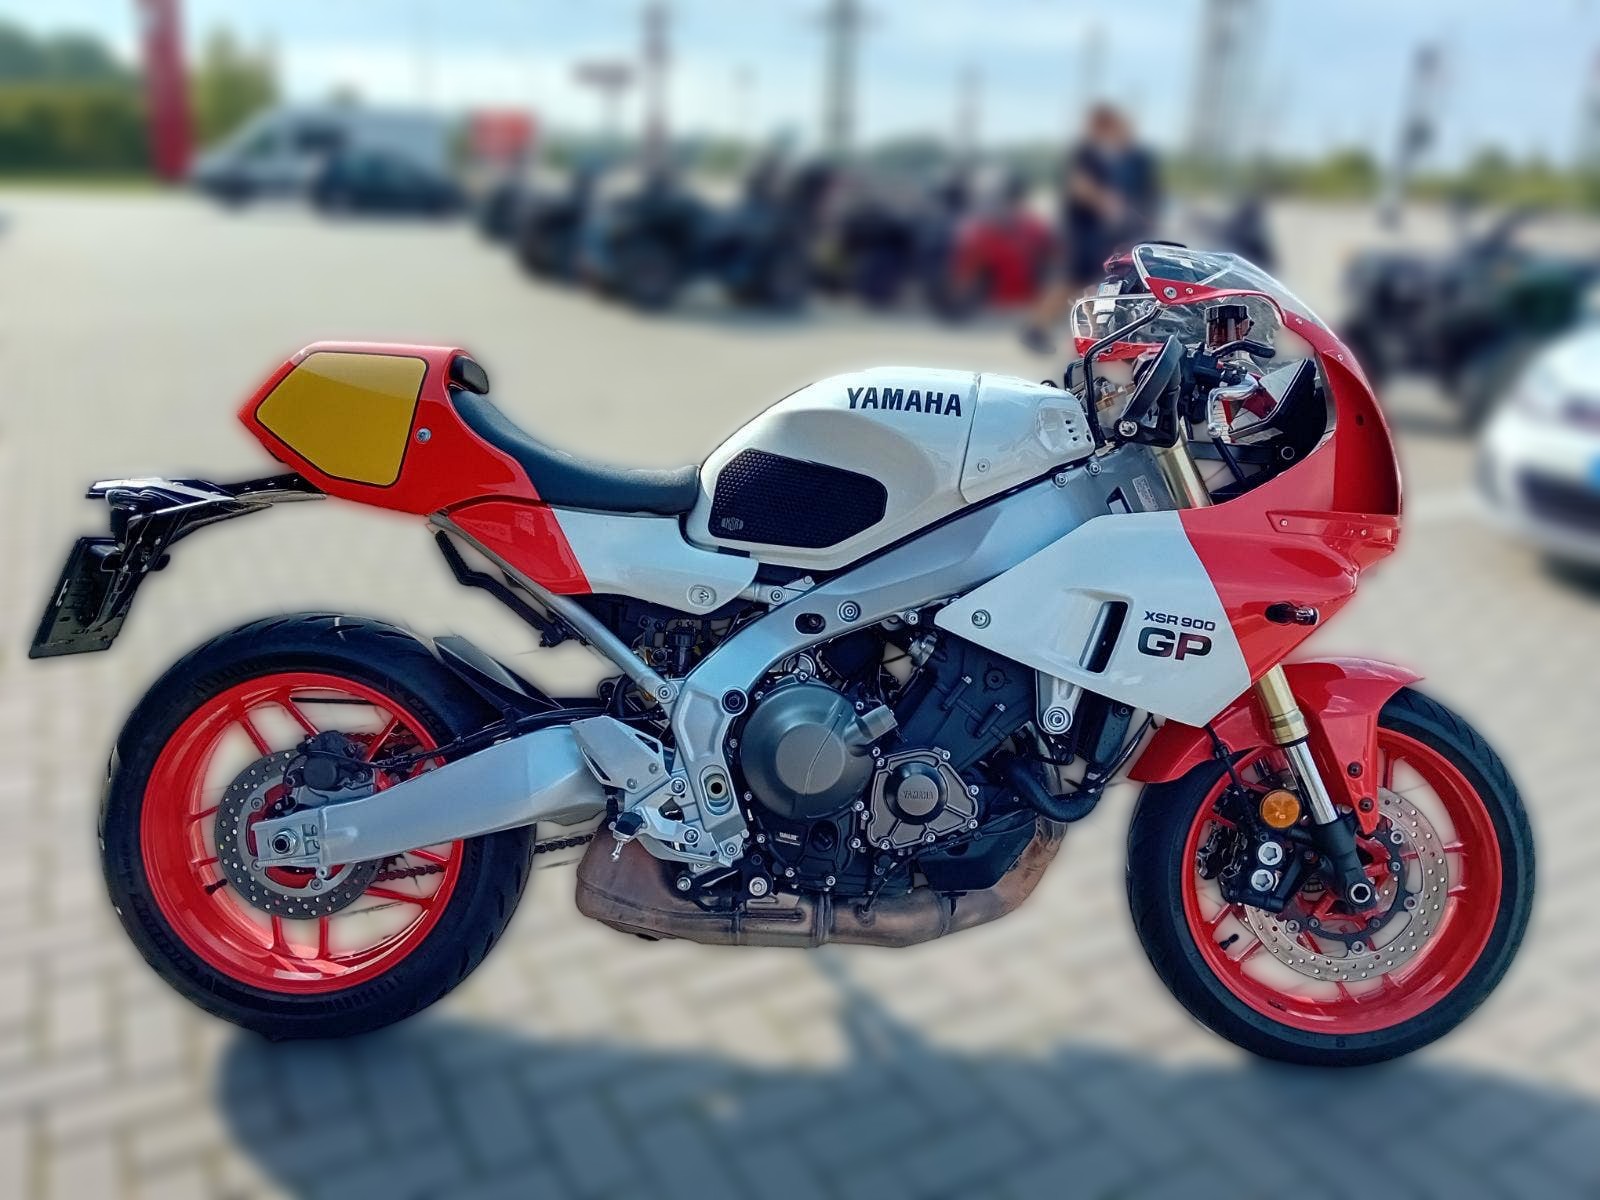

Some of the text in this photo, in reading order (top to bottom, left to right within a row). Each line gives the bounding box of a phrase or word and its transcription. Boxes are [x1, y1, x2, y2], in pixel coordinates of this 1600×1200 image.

[847, 386, 962, 417] YAMAHA
[1144, 611, 1216, 631] XSR 900
[1137, 626, 1212, 661] GP
[903, 790, 934, 800] YAMAHA
